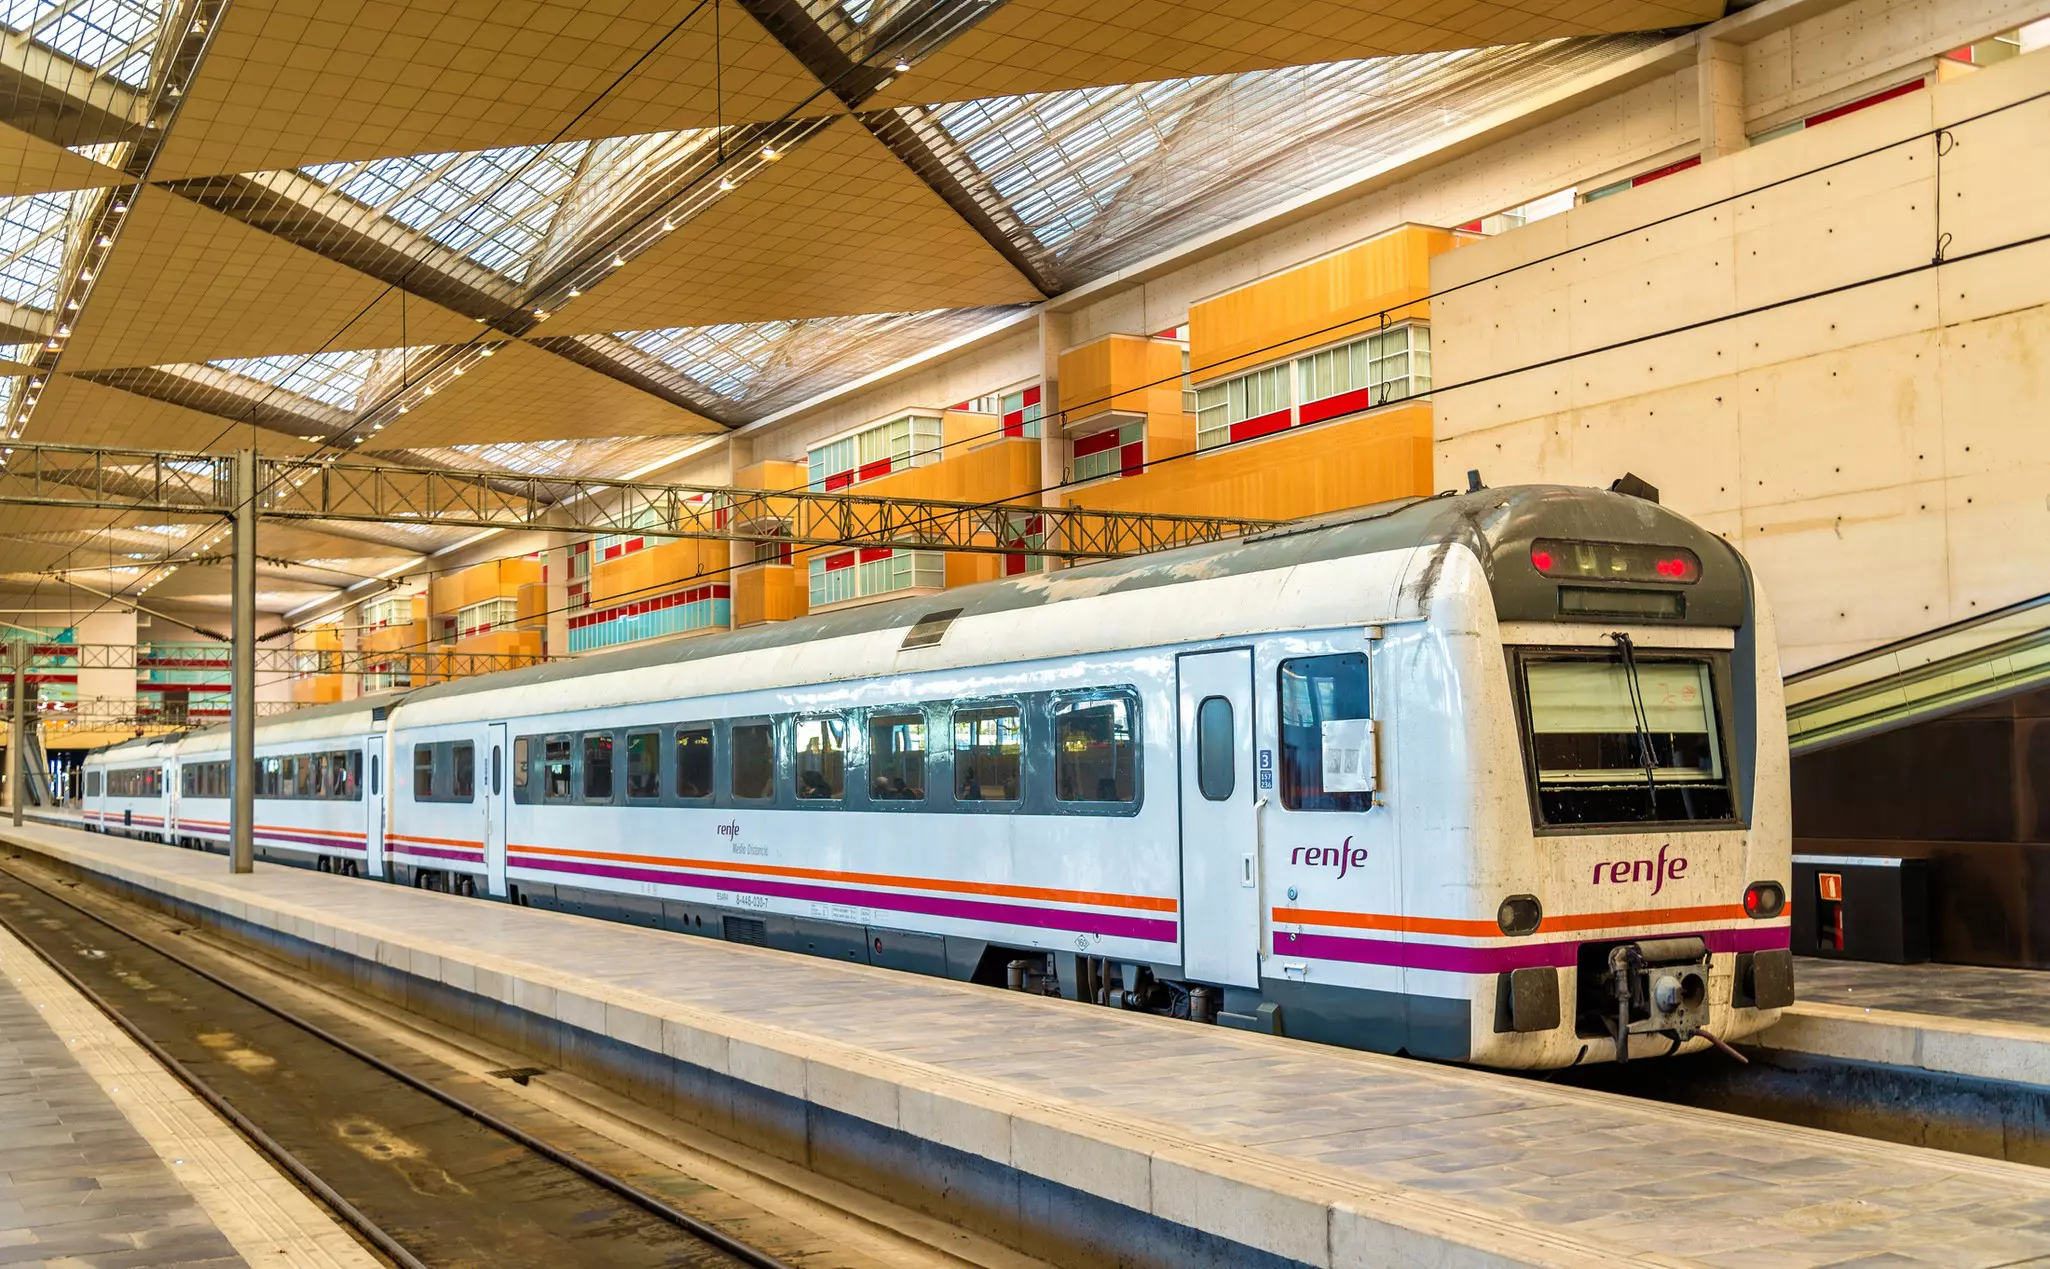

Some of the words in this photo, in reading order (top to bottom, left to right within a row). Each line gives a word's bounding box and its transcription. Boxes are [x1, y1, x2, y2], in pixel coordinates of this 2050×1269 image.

[1262, 754, 1269, 767] 3
[717, 819, 740, 842] renfe
[1291, 835, 1368, 880] renfe
[1592, 843, 1688, 896] renfe
